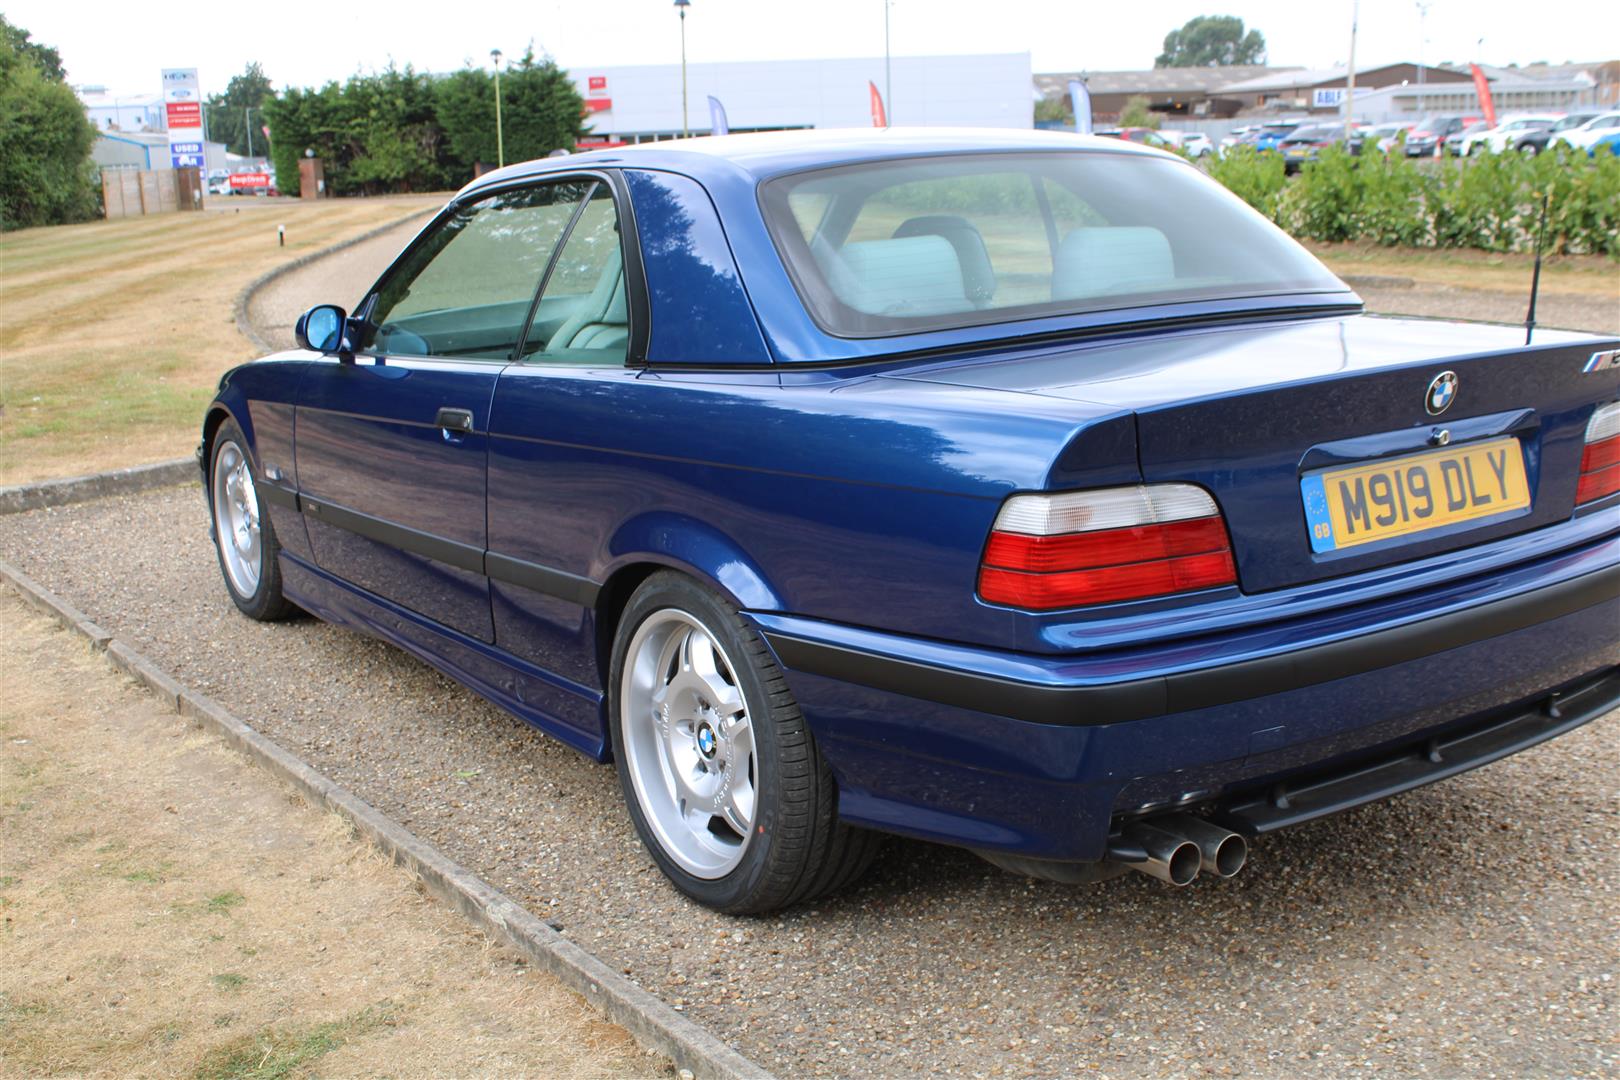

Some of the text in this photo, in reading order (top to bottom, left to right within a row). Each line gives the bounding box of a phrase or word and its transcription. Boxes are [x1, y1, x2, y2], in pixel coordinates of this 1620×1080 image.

[175, 144, 198, 153] USED
[1339, 449, 1508, 534] M919 DLY
[1314, 522, 1330, 539] GB
